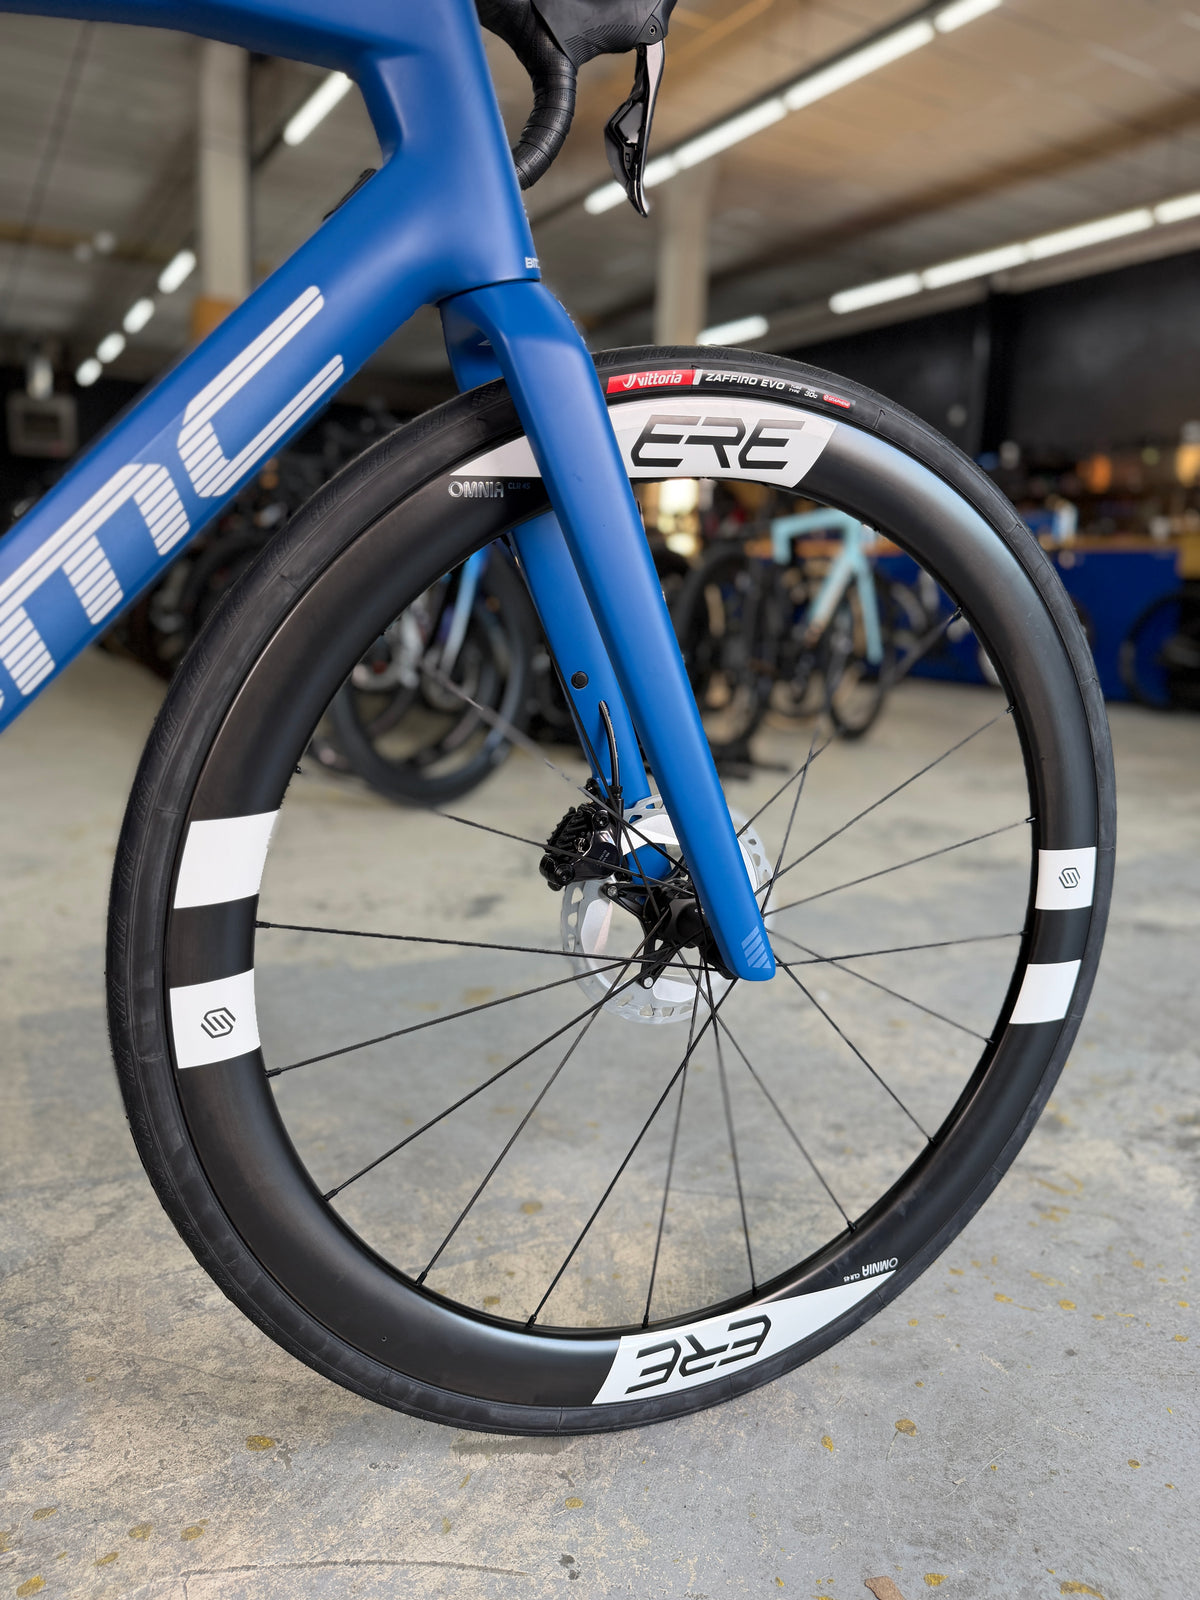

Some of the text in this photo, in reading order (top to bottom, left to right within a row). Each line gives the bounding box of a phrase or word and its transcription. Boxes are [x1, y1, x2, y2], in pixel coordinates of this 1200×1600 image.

[637, 371, 683, 387] vittoria
[705, 373, 786, 390] ZAFFIRO EVO
[631, 414, 805, 470] ERE
[448, 481, 504, 498] OMNIA
[862, 1257, 898, 1276] OMNIA
[624, 1314, 771, 1395] ERE
